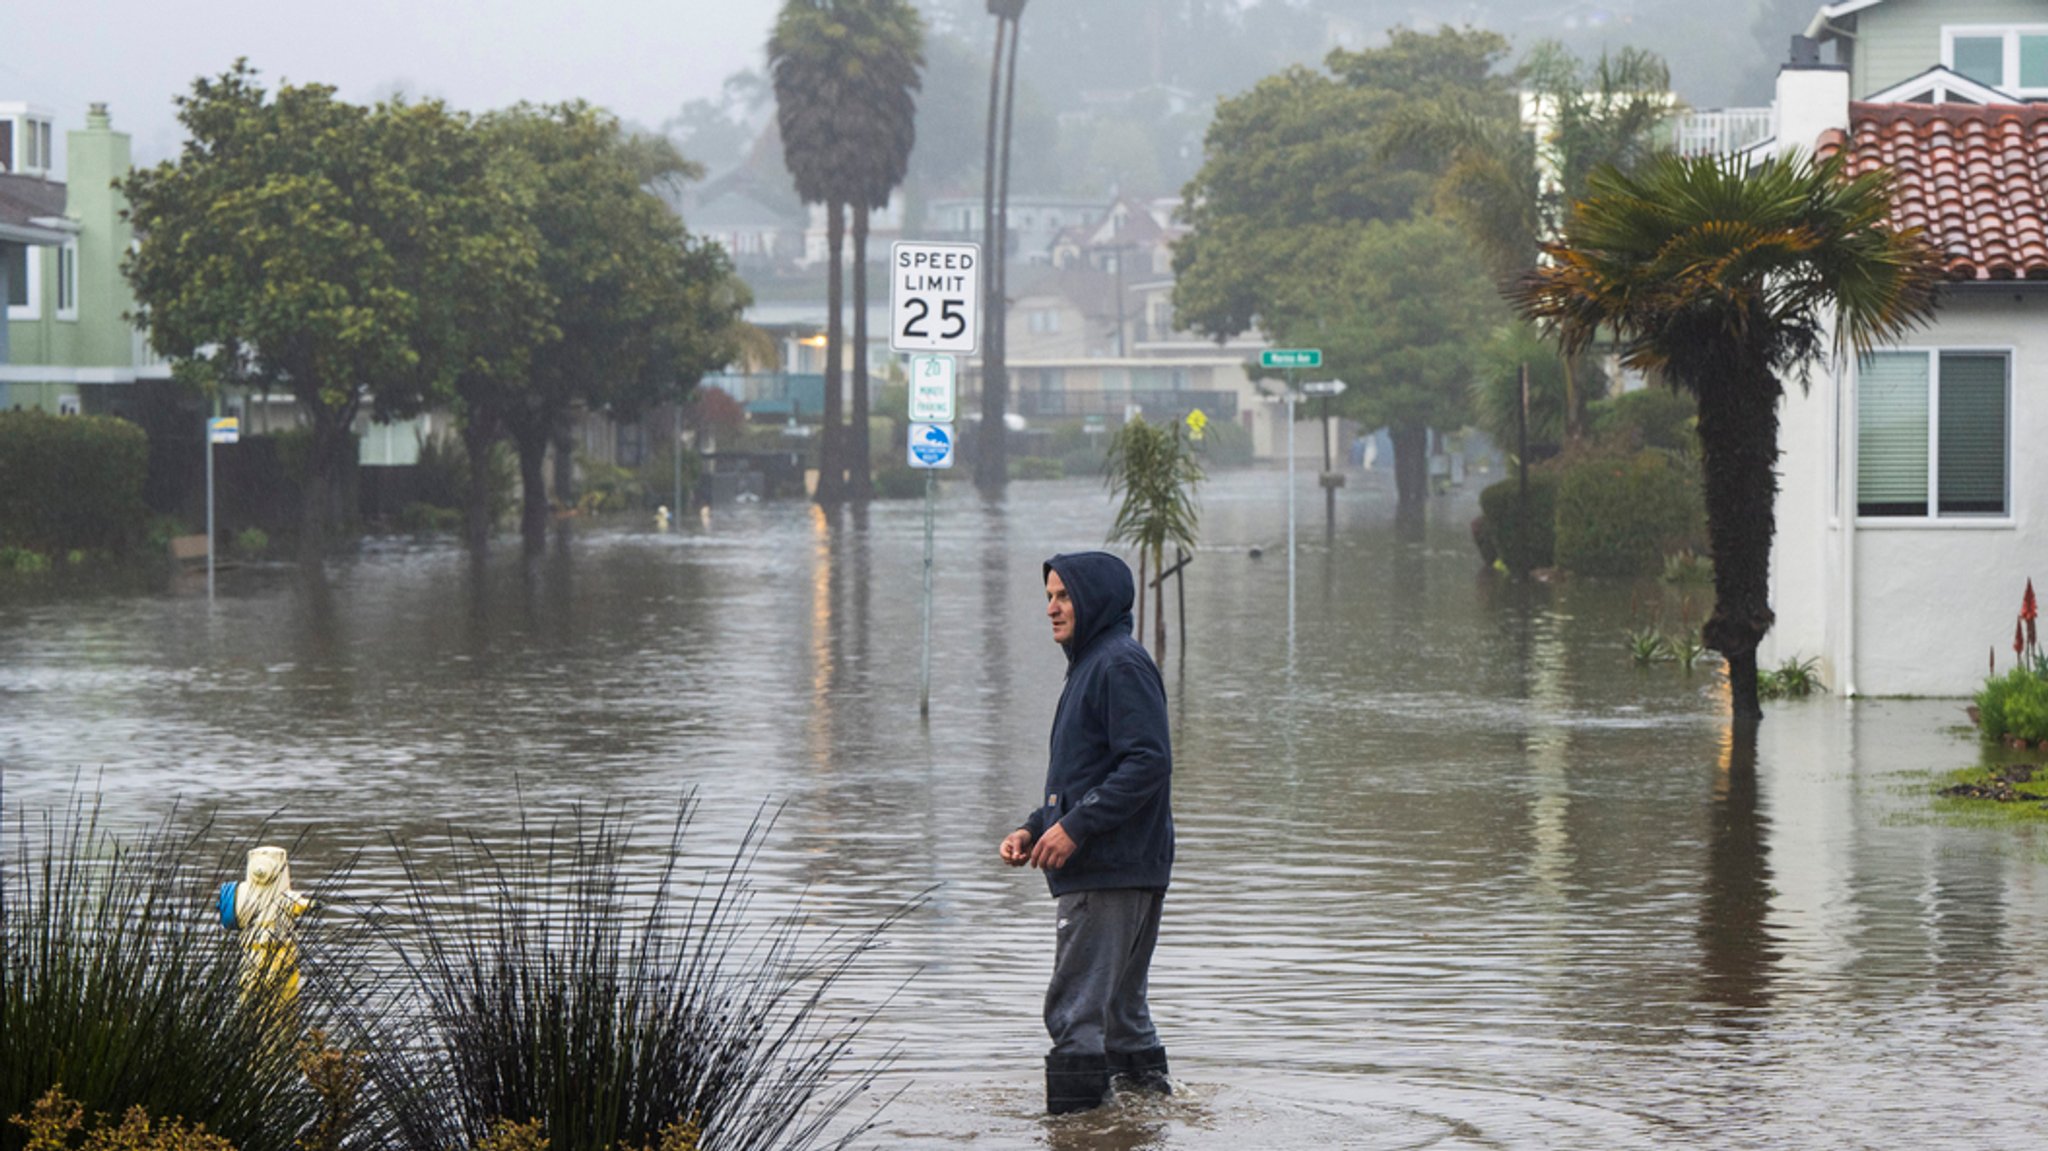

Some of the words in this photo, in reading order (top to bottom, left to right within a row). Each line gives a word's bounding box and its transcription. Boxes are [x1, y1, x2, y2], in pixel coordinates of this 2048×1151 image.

[899, 252, 973, 269] SPEED
[905, 276, 965, 291] LIMIT
[902, 298, 967, 339] 25
